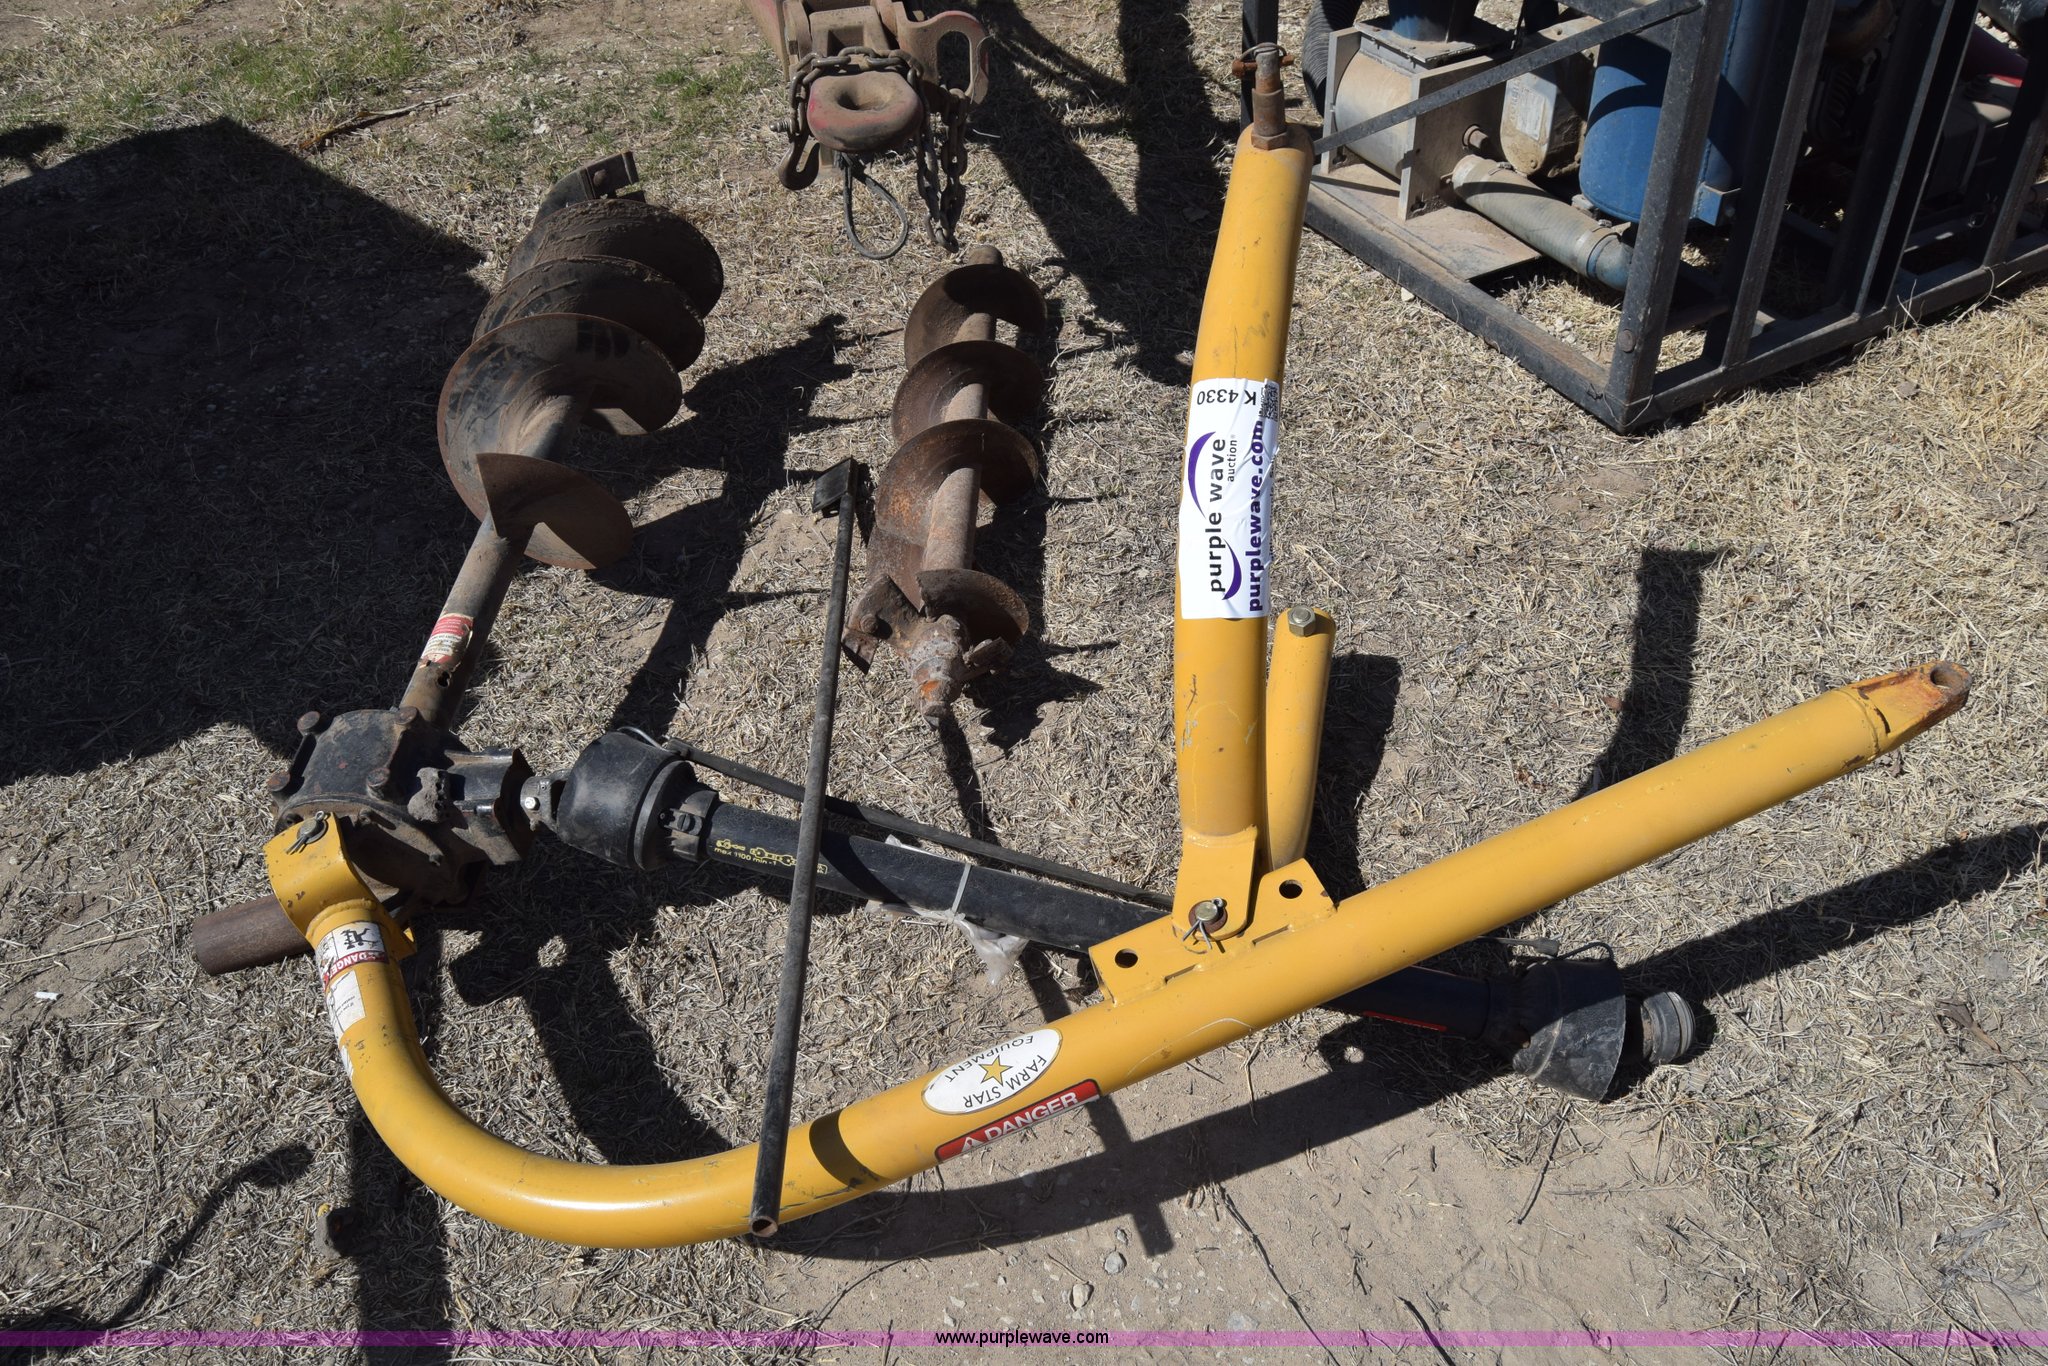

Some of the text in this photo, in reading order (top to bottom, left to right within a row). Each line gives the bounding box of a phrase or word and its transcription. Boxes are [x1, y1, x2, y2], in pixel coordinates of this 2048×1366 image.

[1196, 388, 1239, 406] 4330
[1244, 389, 1257, 406] K
[1205, 438, 1226, 592] purple wave
[1245, 420, 1265, 612] purplewave.com
[733, 851, 752, 862] 1100
[944, 1035, 1034, 1083] EQUIPMENT
[963, 1054, 1047, 1108] FARM STAR
[984, 1091, 1080, 1142] DANGER
